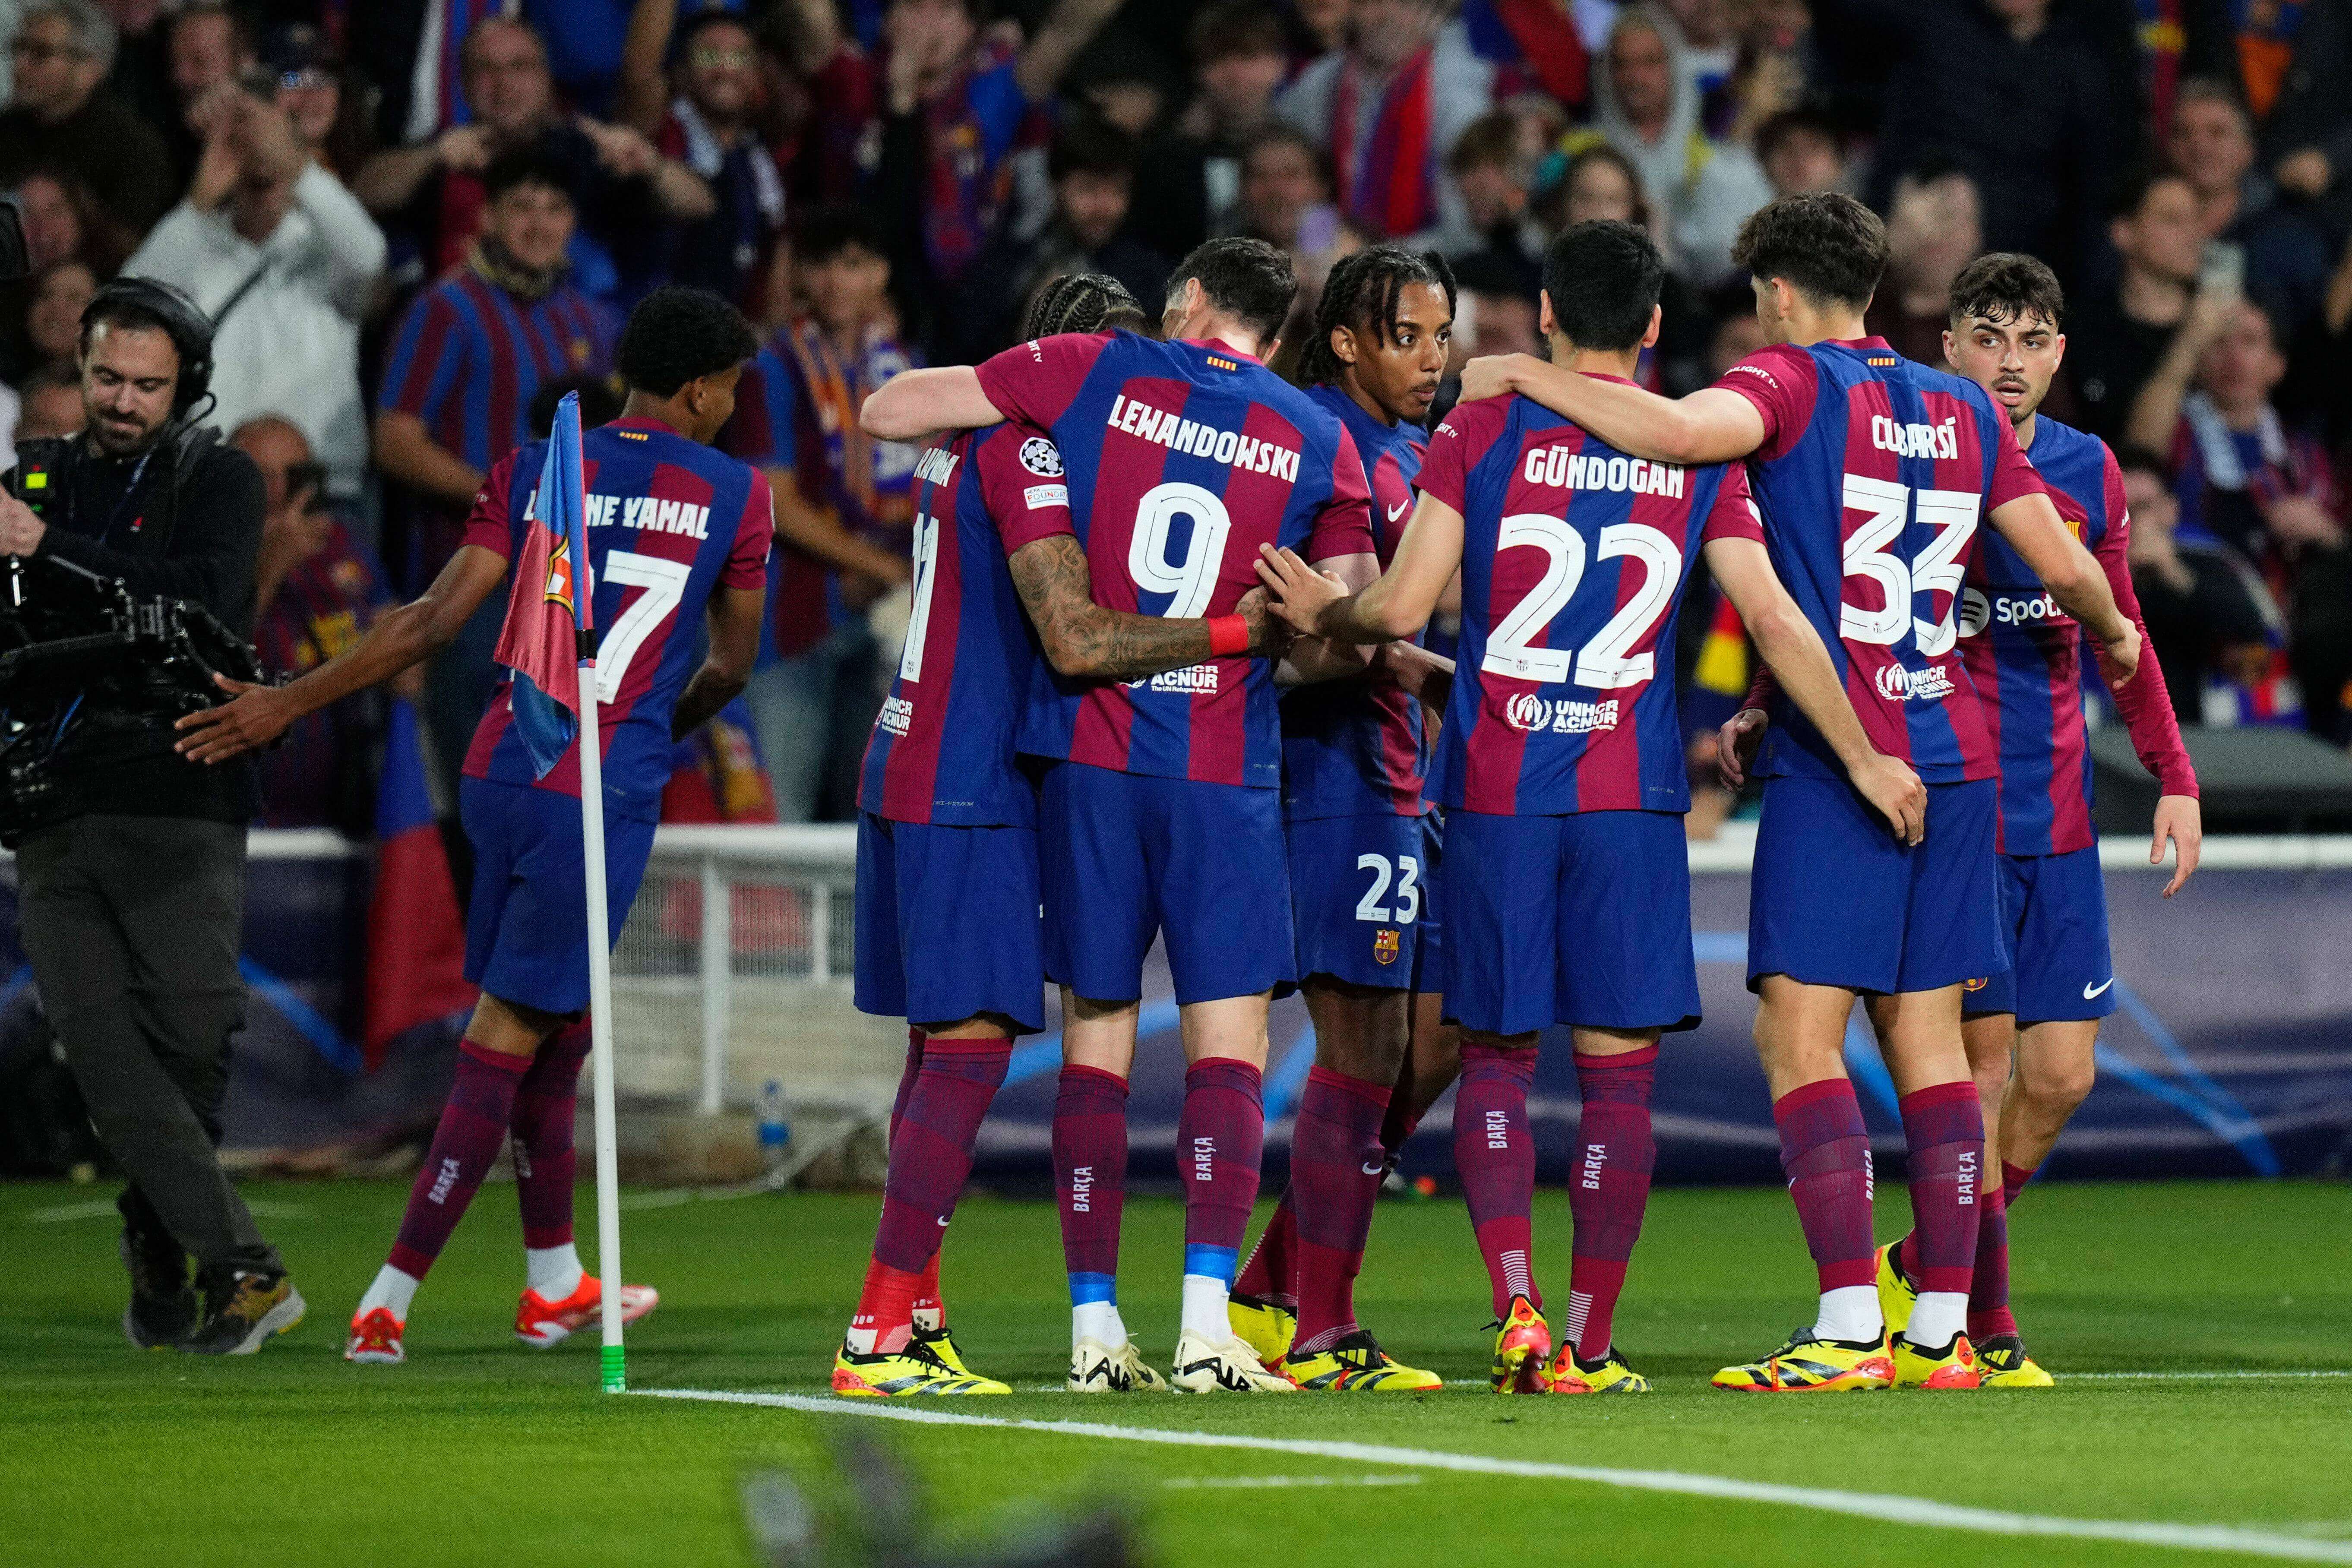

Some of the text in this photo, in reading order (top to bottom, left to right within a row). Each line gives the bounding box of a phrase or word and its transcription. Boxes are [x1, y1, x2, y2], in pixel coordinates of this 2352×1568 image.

[1107, 394, 1300, 484] LEWANDOWSKI
[1871, 415, 1958, 460] CUBARSÍ
[1524, 445, 1684, 499] GÜNDOGAN
[523, 490, 711, 541] LNE YAMAL
[1128, 482, 1232, 619] 9
[1840, 473, 1982, 657] 33
[1481, 513, 1682, 689] 22
[1995, 594, 2068, 626] Spot
[587, 550, 692, 705] 7
[1151, 671, 1218, 688] ACNUR
[1908, 665, 1946, 686] NHCR
[882, 710, 911, 731] ACNUR
[1552, 711, 1618, 729] ACNUR
[1555, 699, 1619, 717] UNHCR
[1356, 853, 1419, 924] 23
[1486, 1110, 1510, 1149] BARÇA
[1194, 1136, 1217, 1181] BARÇA
[1582, 1144, 1608, 1190] BARÇA
[1958, 1151, 1978, 1205] BARÇA
[1073, 1166, 1095, 1213] BARÇA
